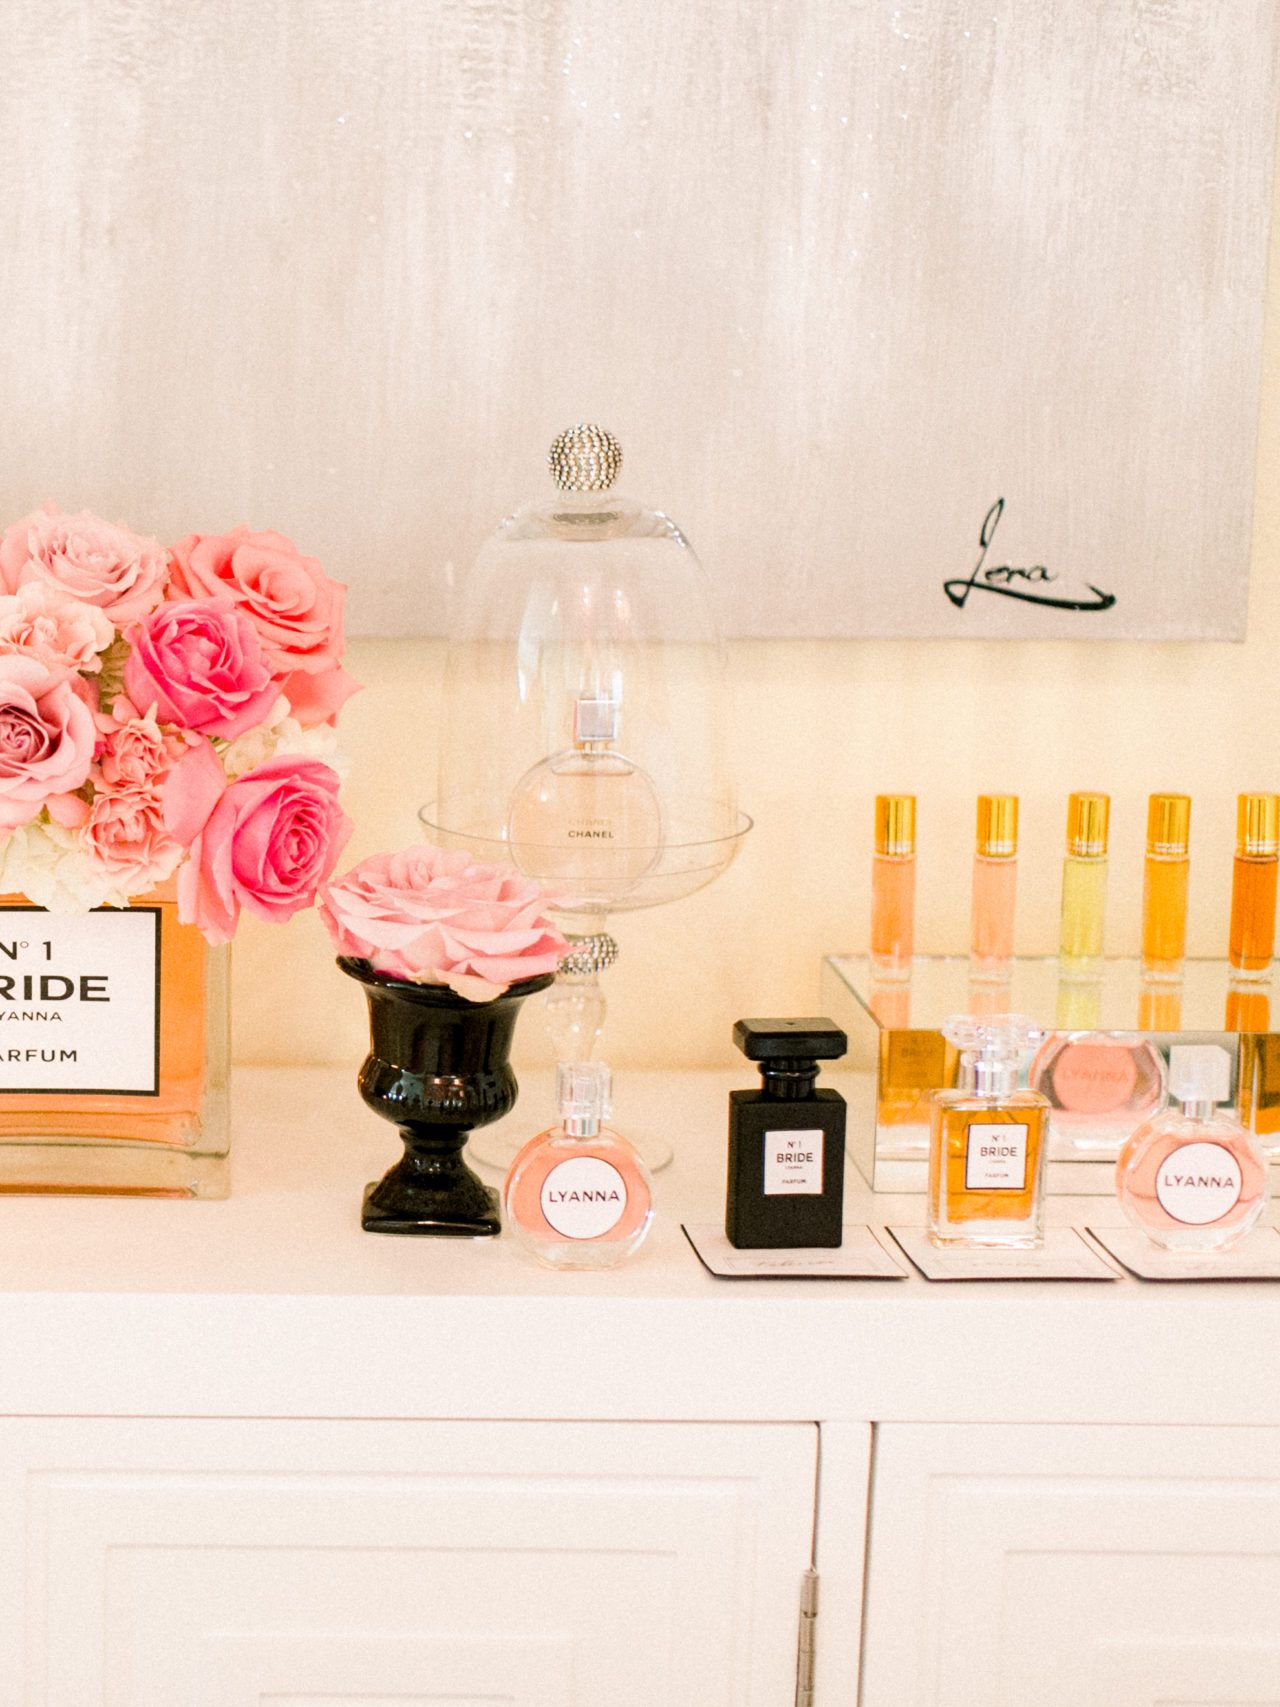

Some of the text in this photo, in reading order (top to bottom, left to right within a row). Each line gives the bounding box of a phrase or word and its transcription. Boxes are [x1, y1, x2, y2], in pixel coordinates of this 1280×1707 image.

[568, 830, 614, 838] CHANEL
[42, 941, 51, 960] 1
[980, 1146, 1018, 1157] BRIDE
[776, 1152, 814, 1163] BRIDE
[1165, 1175, 1234, 1188] LYANNA
[549, 1190, 620, 1202] LYANNA
